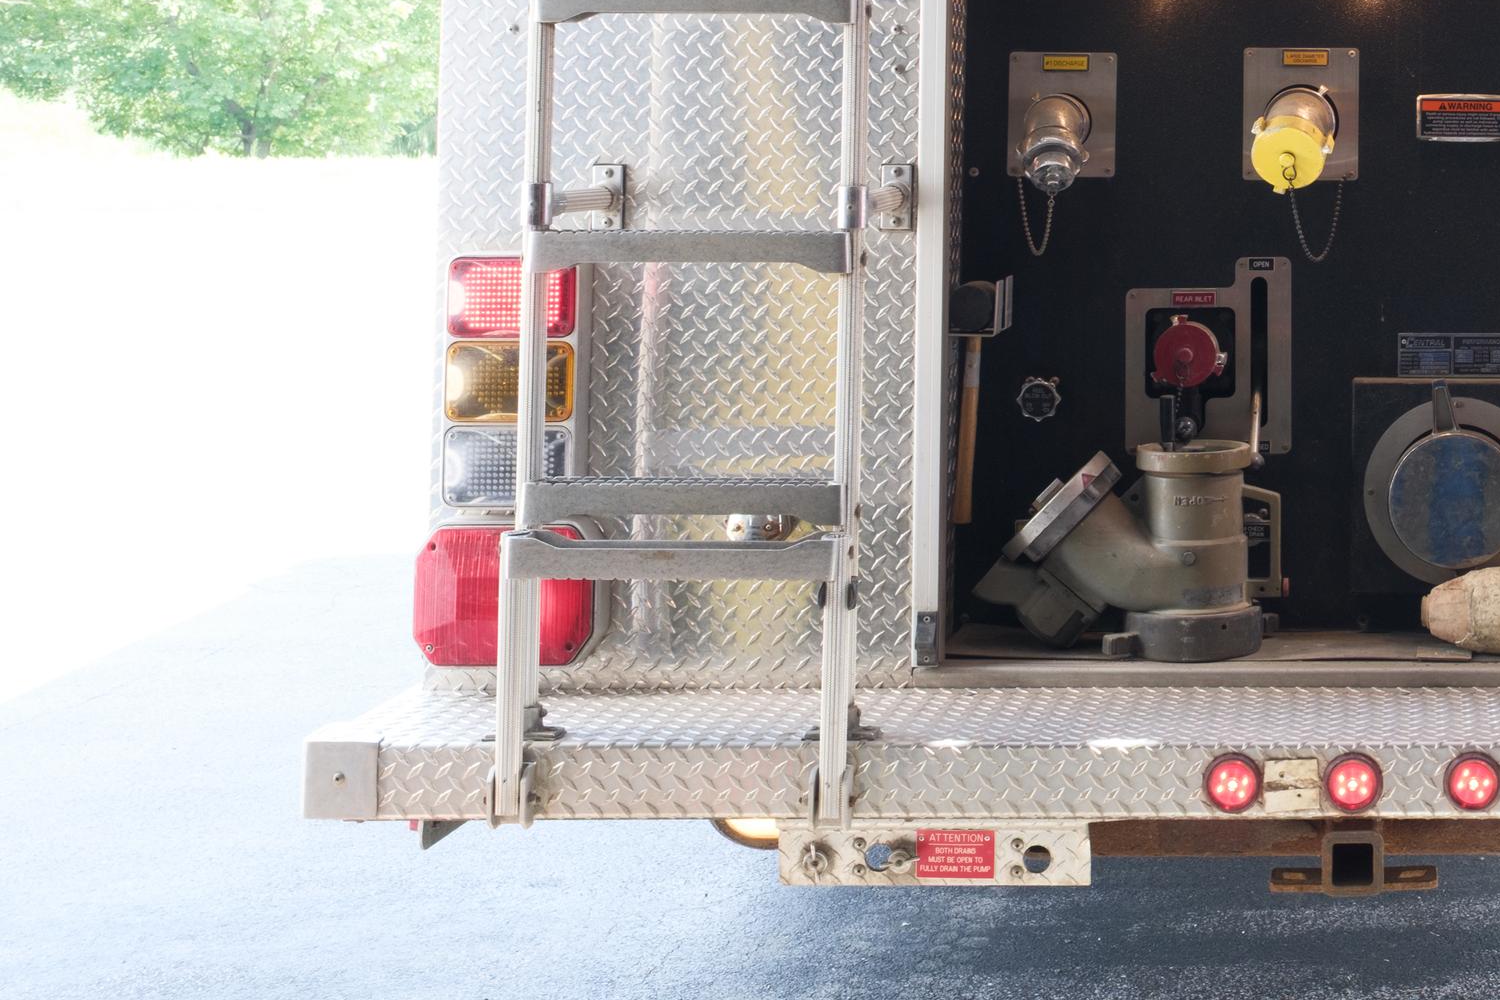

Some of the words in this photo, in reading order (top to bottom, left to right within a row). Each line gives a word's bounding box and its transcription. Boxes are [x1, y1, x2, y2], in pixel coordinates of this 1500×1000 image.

[1406, 336, 1445, 347] CENTRAL
[1173, 495, 1204, 506] OPEN
[929, 833, 984, 843] ATTENTION
[954, 847, 976, 855] DRAINS
